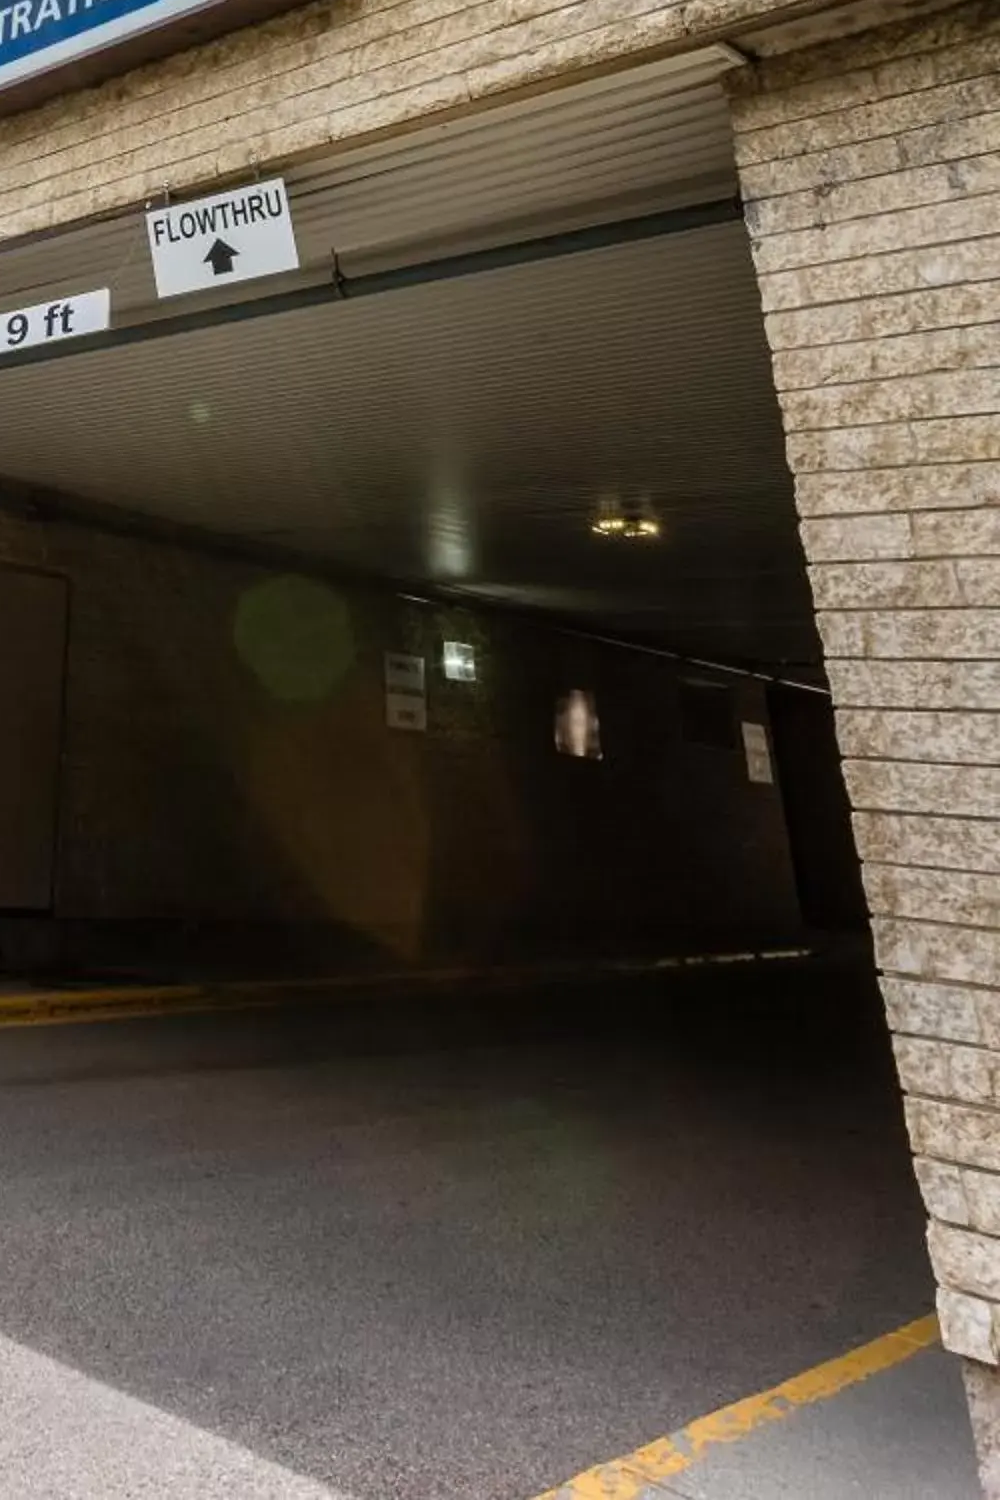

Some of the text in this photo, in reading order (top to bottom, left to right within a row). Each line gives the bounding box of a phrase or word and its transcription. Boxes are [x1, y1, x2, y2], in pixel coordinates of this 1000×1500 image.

[153, 189, 283, 247] FLOWTHRU
[6, 314, 29, 345] 9
[43, 303, 74, 337] ft
